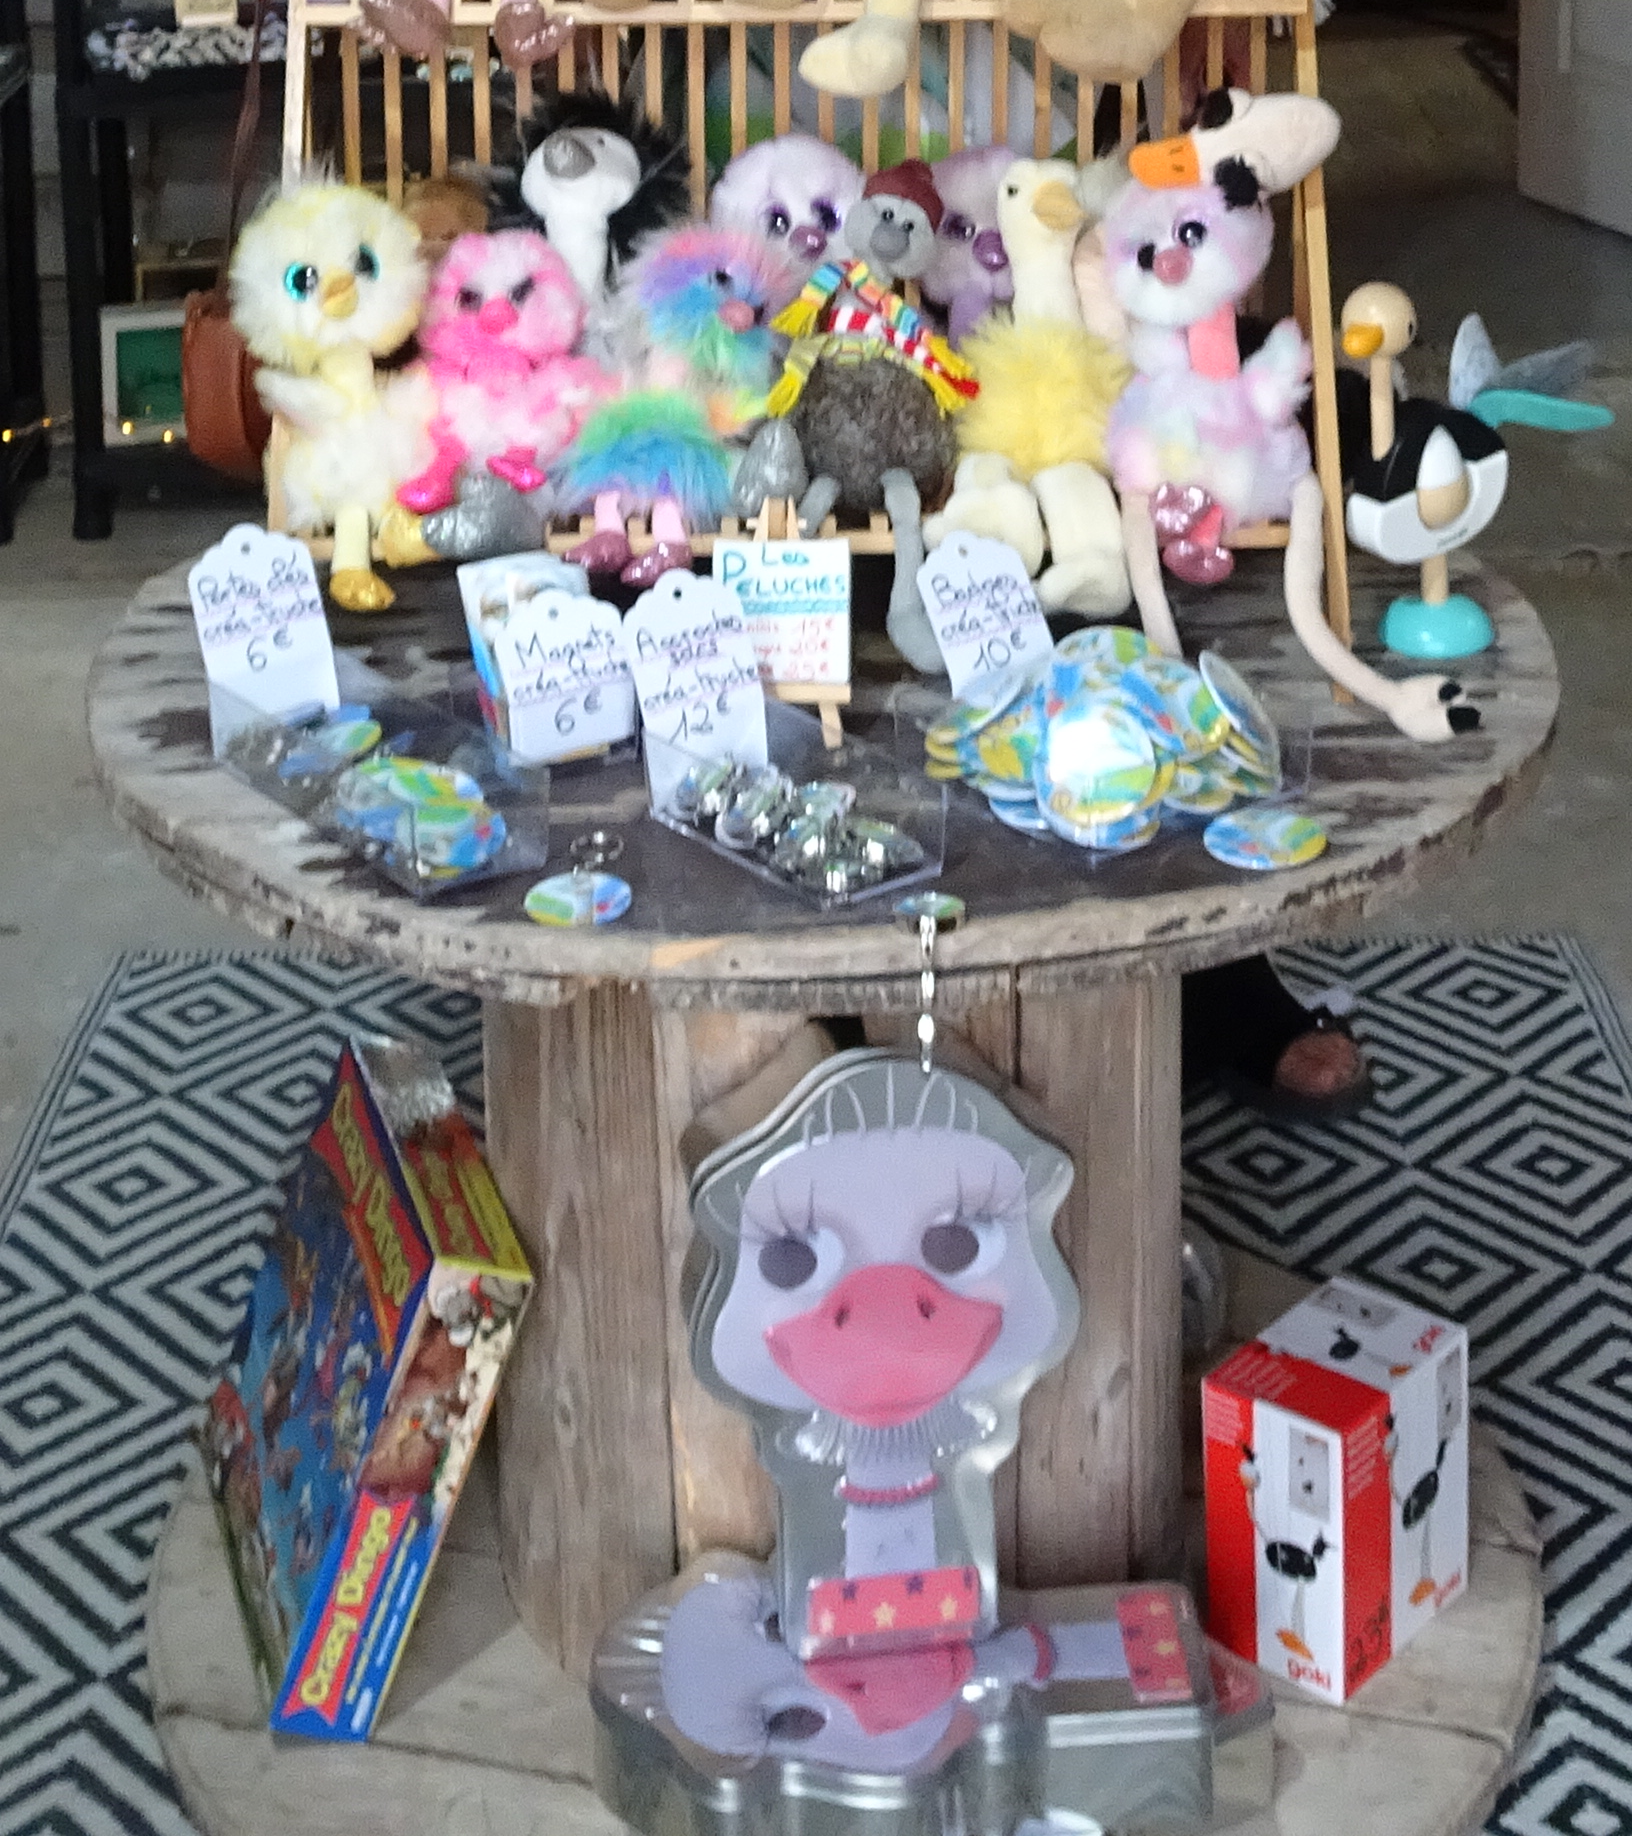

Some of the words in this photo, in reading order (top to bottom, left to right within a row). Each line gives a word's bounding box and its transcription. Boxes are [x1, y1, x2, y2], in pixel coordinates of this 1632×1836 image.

[723, 550, 846, 597] PELUCHES
[761, 543, 810, 566] Les
[931, 569, 1018, 608] Badges
[515, 624, 616, 670] Magnets
[364, 1171, 412, 1308] Dingo
[300, 1609, 358, 1705] Crazy
[335, 1505, 392, 1607] Dingo
